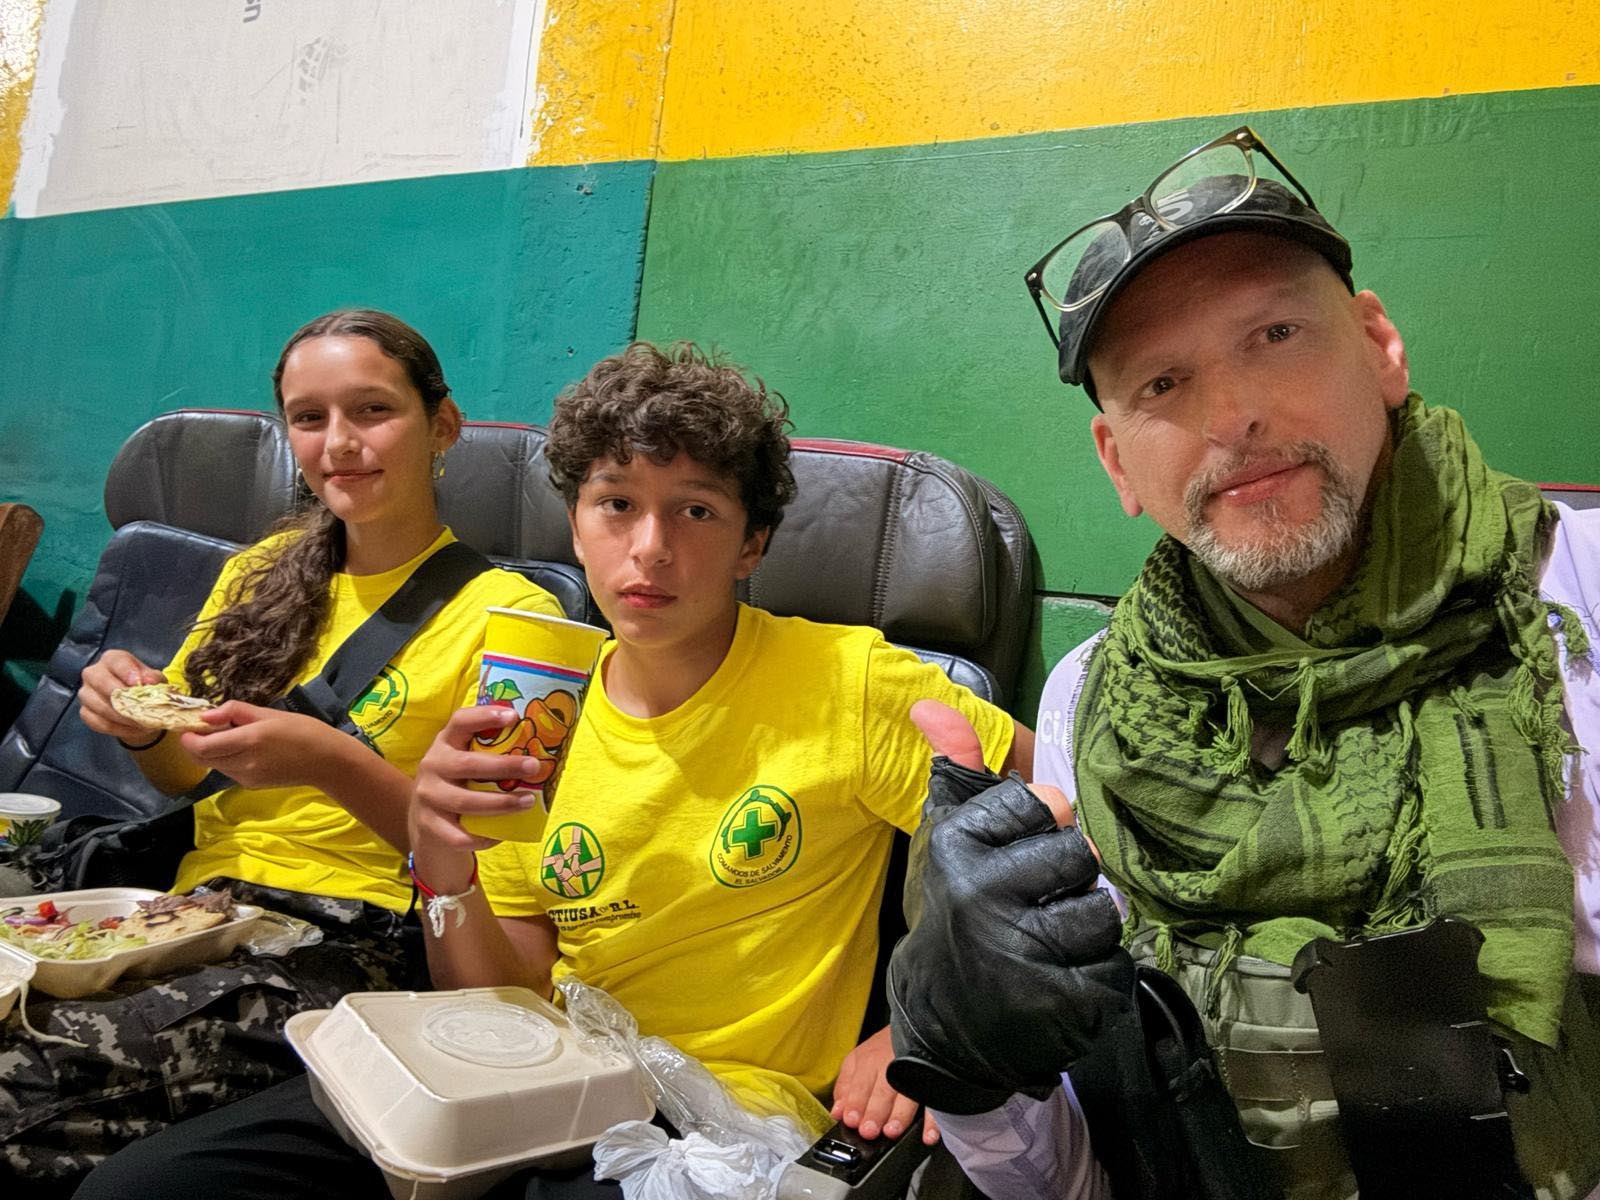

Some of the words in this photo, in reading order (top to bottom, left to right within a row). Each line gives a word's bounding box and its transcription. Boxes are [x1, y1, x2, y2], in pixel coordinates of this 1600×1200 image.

[717, 852, 749, 877] COMANDOS
[750, 870, 760, 878] DE
[761, 834, 793, 875] SALVAMENTO
[746, 867, 784, 884] SALVADOR
